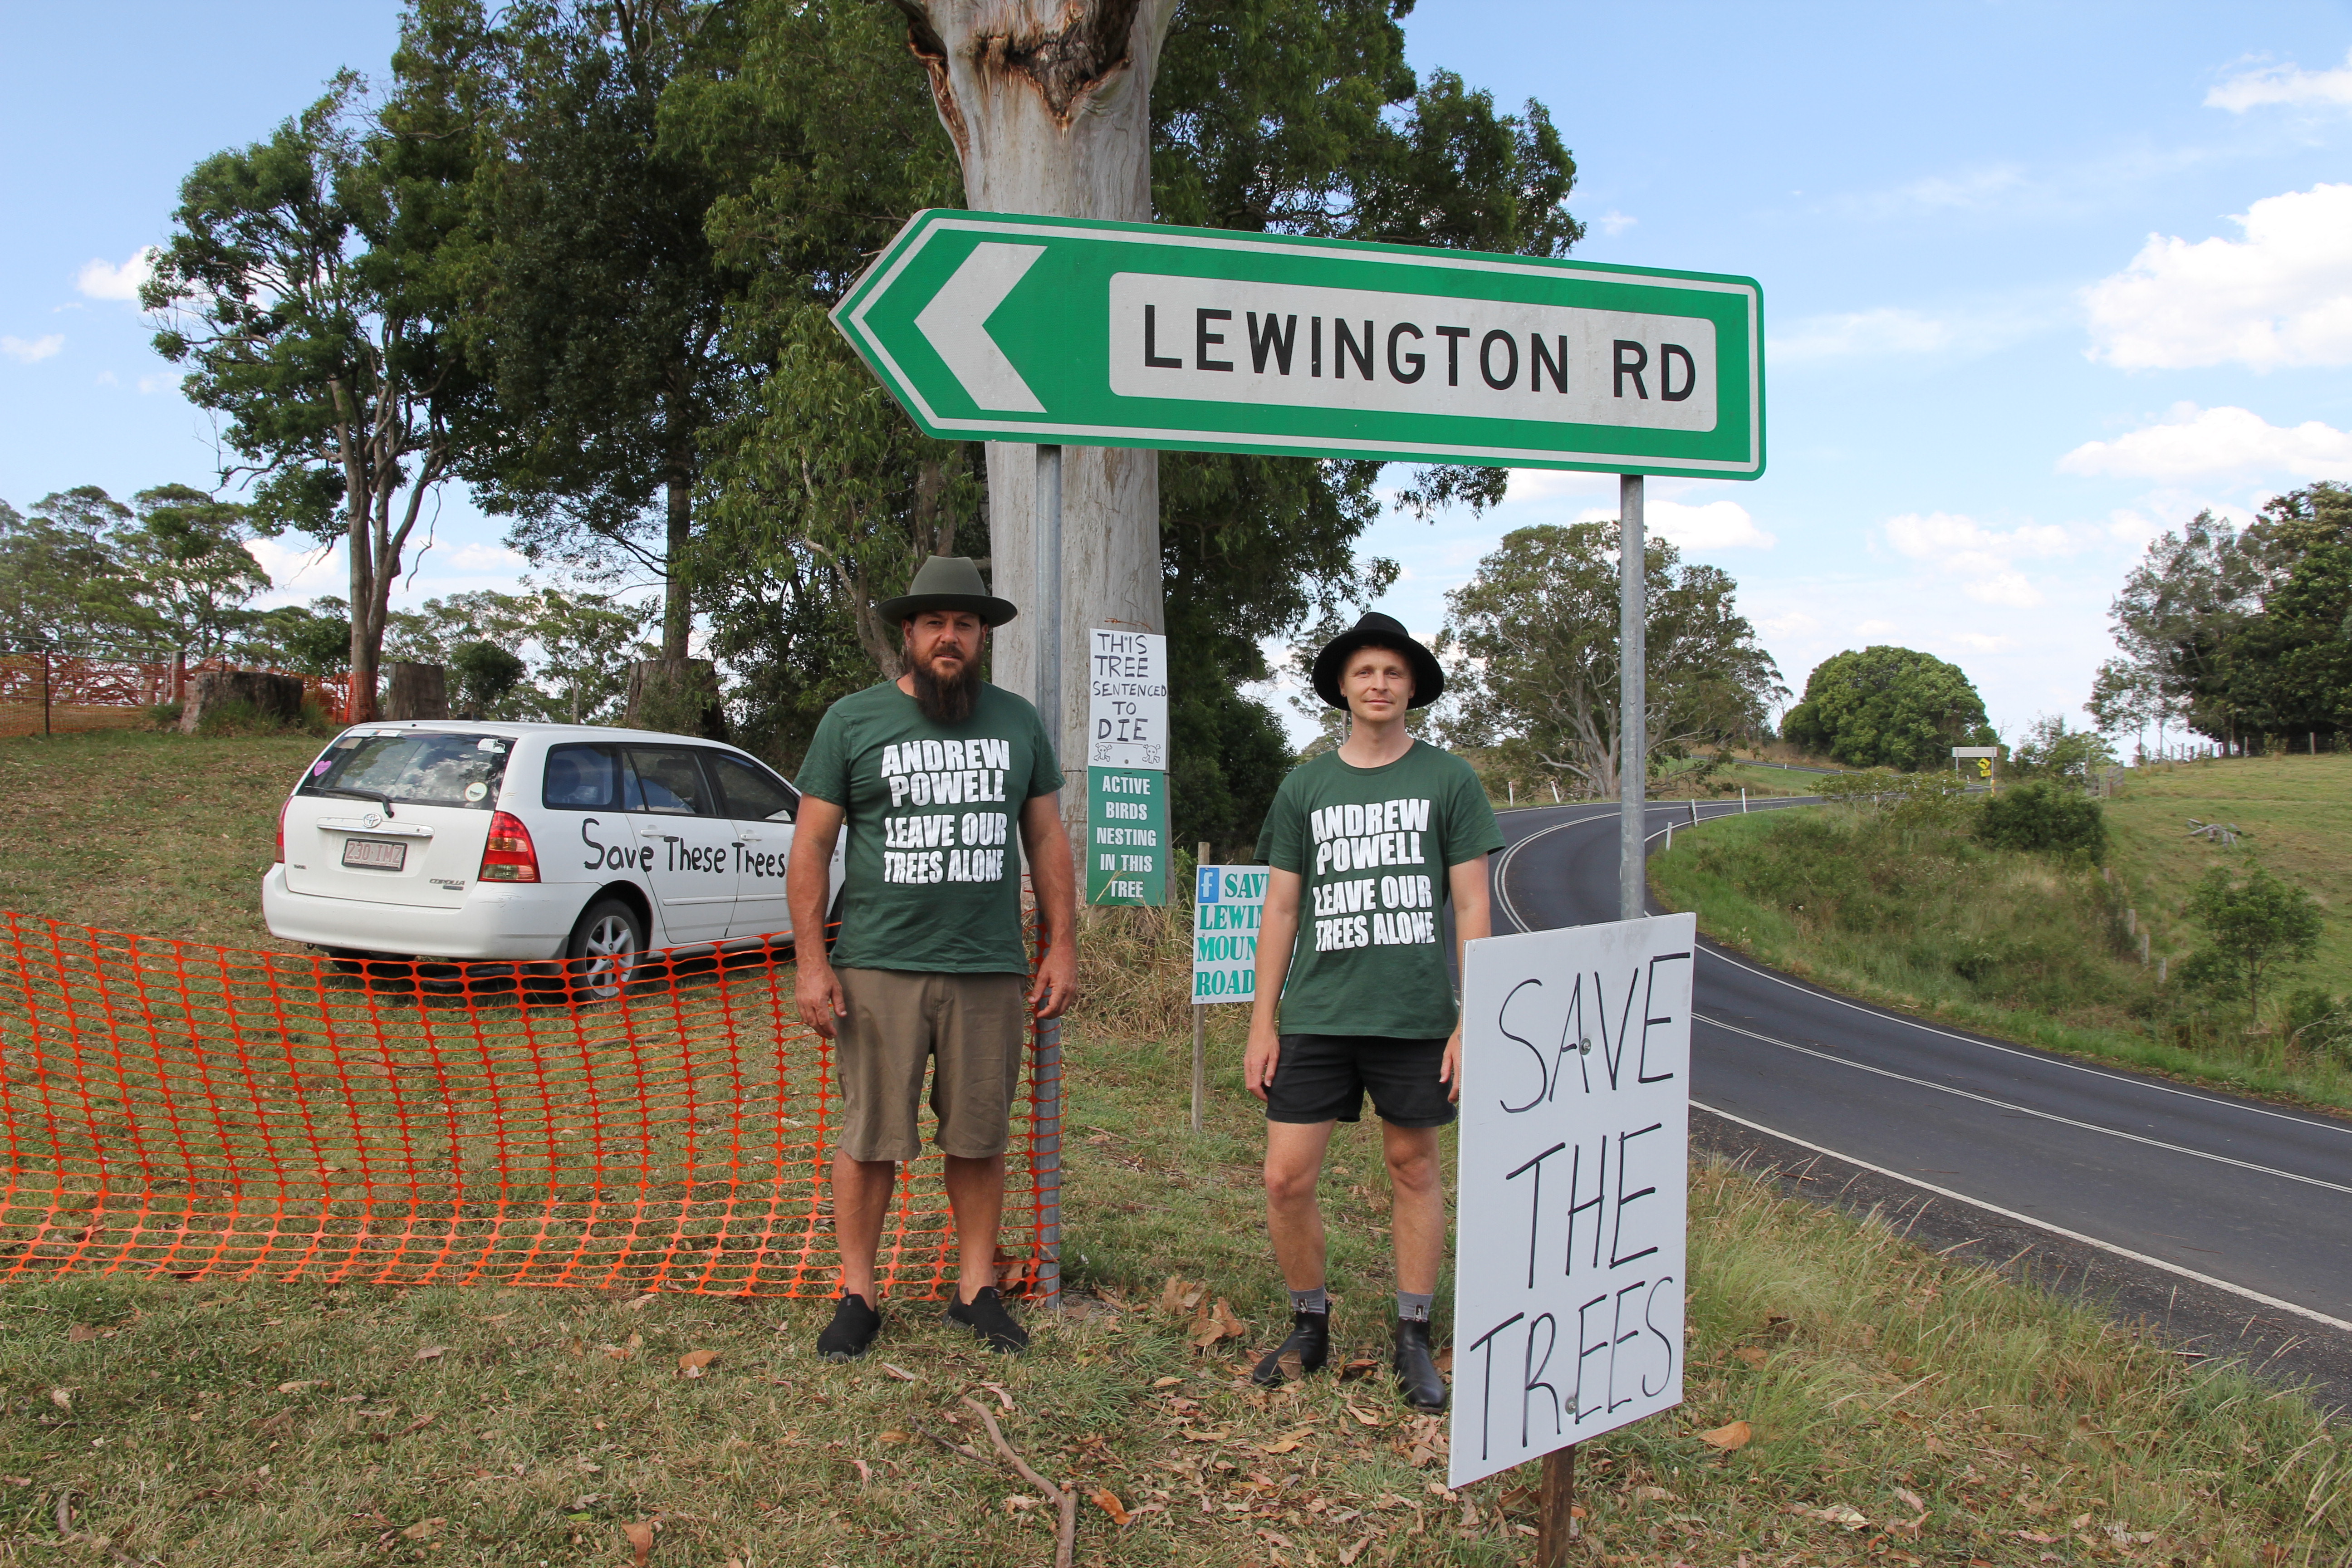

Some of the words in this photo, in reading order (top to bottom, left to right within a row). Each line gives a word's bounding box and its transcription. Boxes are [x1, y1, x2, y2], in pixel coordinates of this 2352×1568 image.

[1144, 304, 1568, 395] LEWINGTON
[1613, 339, 1696, 402] RD
[1097, 633, 1147, 654] THIS
[1094, 655, 1149, 677] TREE
[1093, 681, 1167, 697] SENTENCED
[1112, 701, 1137, 715] TO
[1098, 718, 1149, 742] DIE
[881, 738, 1010, 778] ANDREW
[888, 769, 1006, 807] POWELL
[1102, 775, 1151, 795] ACTIVE
[1106, 801, 1147, 821] BIRDS
[1311, 798, 1430, 845] ANDREW
[582, 818, 655, 872] Save
[663, 836, 726, 873] These
[731, 842, 787, 878] Trees
[884, 814, 956, 848] LEAVE
[961, 812, 1008, 846] OUR
[1096, 827, 1156, 847] NESTING
[883, 850, 944, 884] TREES
[946, 848, 1004, 883] ALONE
[1100, 853, 1115, 871] IN
[1121, 854, 1153, 872] THIS
[1316, 831, 1425, 876] POWELL
[1111, 880, 1144, 898] TREE
[1225, 873, 1269, 898] SAV
[1312, 878, 1377, 917] LEAVE
[1380, 875, 1433, 909] OUR
[1315, 915, 1369, 952] TREES
[1373, 911, 1436, 945] ALONE
[1498, 951, 1690, 1114] SAVE
[1506, 1122, 1662, 1289] THE
[1470, 1276, 1674, 1460] TREES
